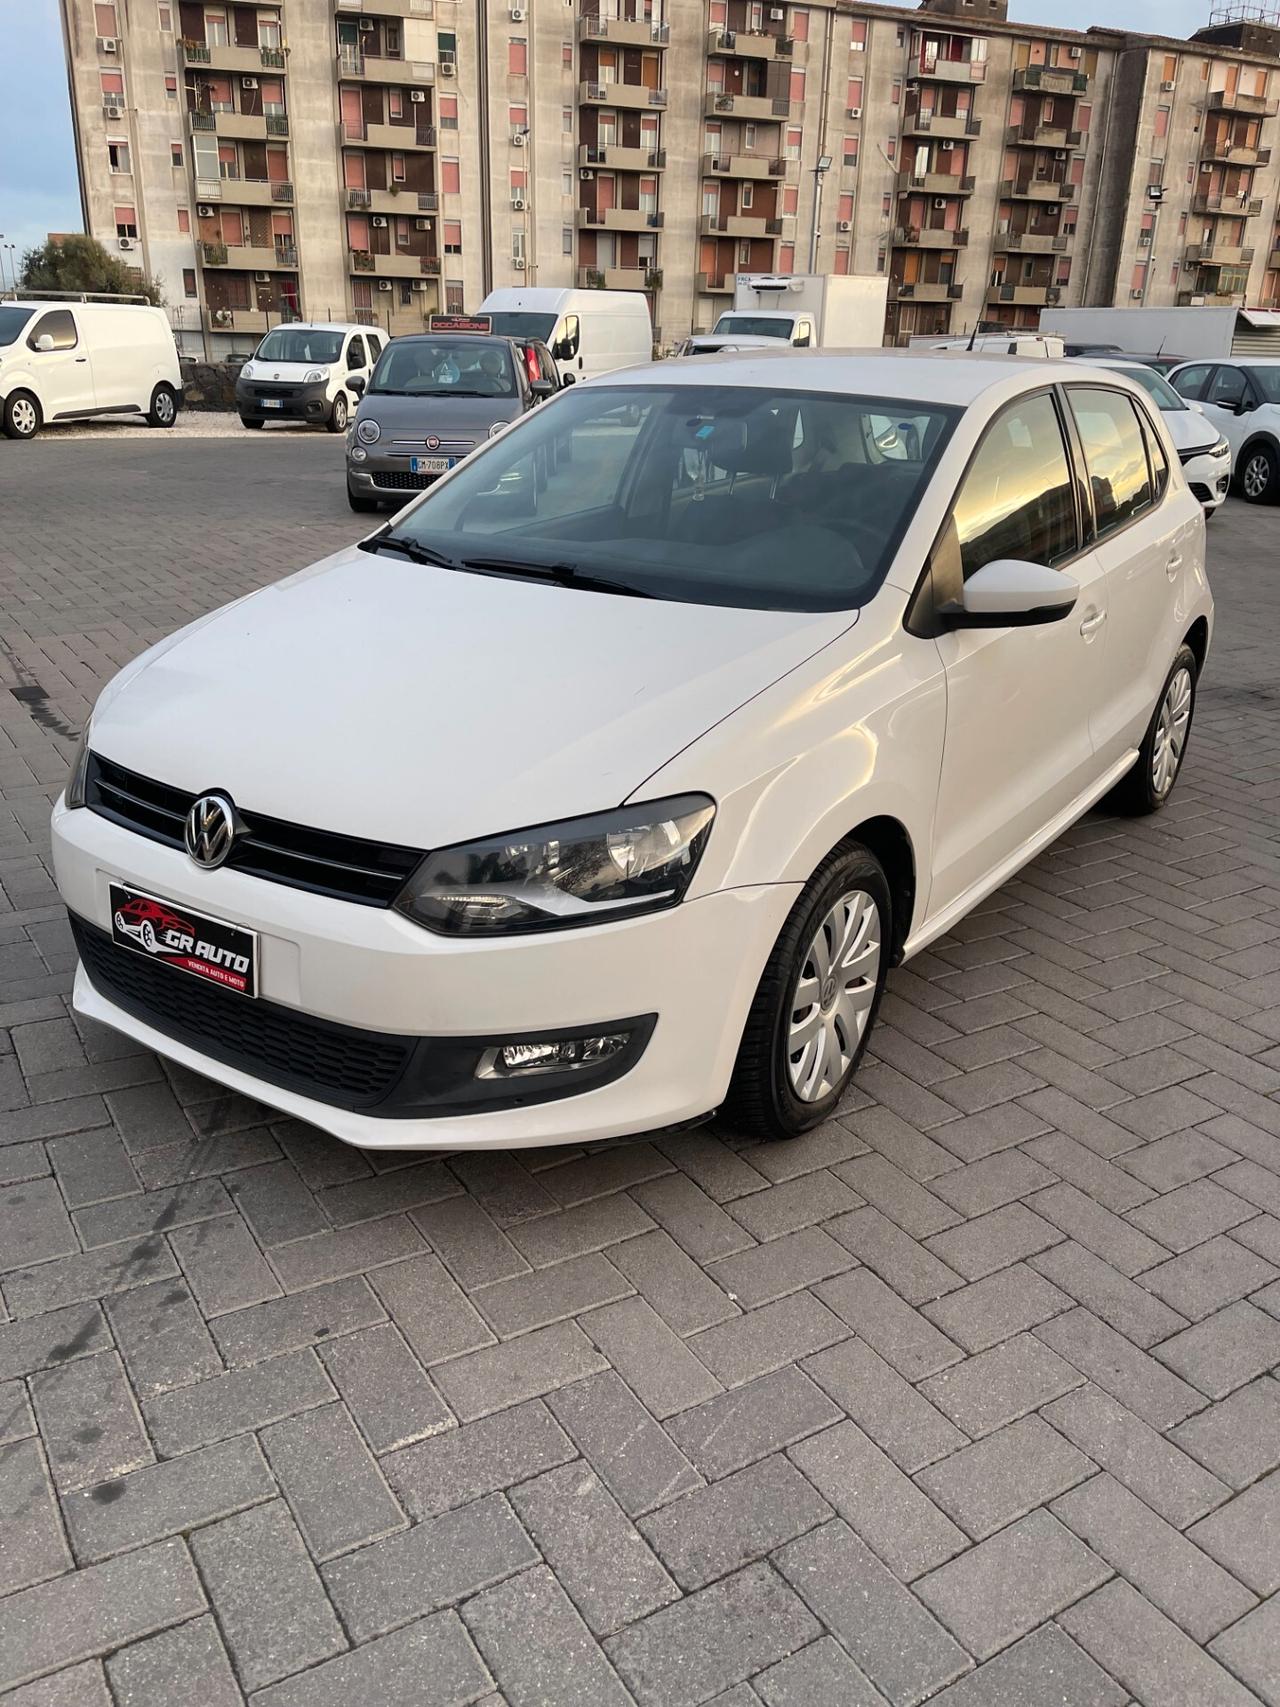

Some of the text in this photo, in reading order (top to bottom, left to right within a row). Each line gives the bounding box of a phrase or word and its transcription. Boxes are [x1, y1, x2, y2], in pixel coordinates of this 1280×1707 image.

[164, 929, 250, 974] GR AUTO
[187, 959, 209, 973] VENDITA
[210, 968, 224, 980] AUTO
[229, 975, 245, 987] MOTO
